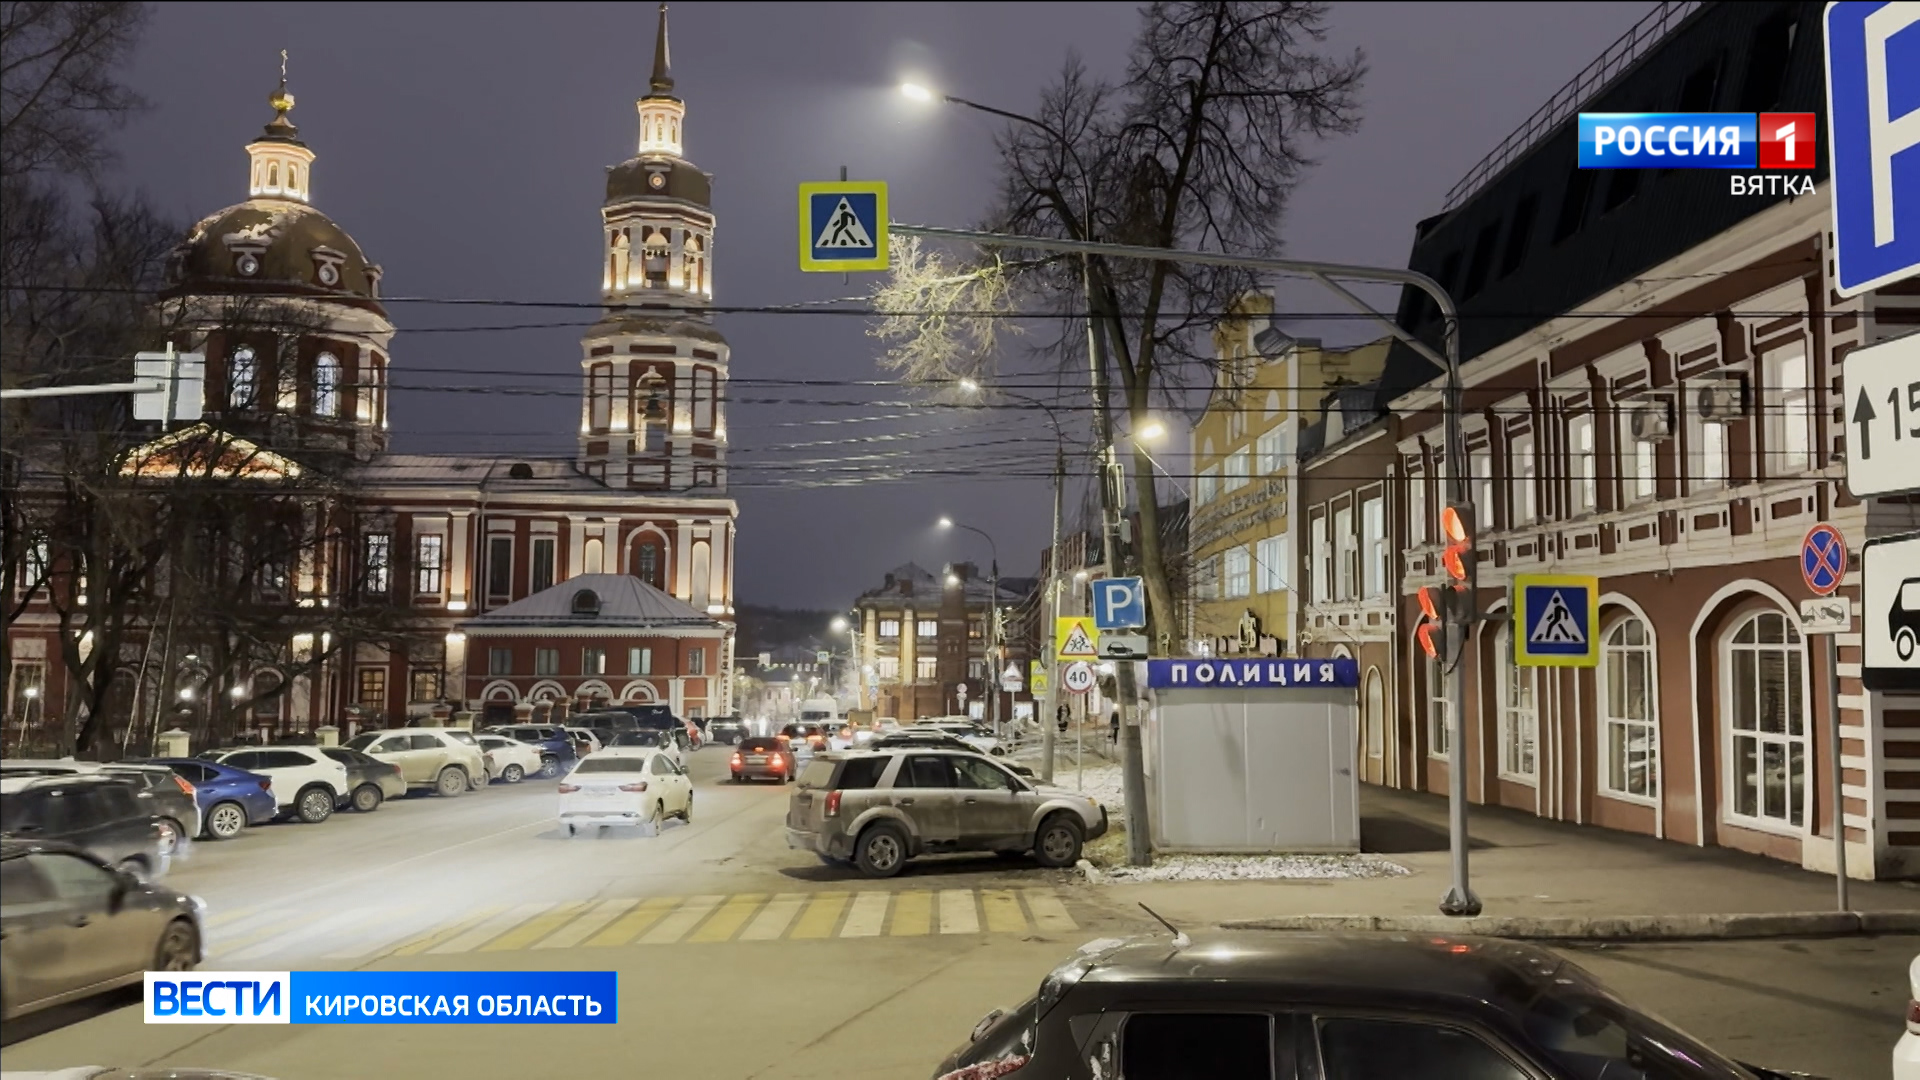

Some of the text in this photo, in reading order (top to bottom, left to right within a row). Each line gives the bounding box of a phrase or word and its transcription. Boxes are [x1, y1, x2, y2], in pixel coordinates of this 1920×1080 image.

[1105, 585, 1133, 622] P
[1069, 671, 1088, 683] 40
[1171, 663, 1335, 686] ПОЛИЦИЯ
